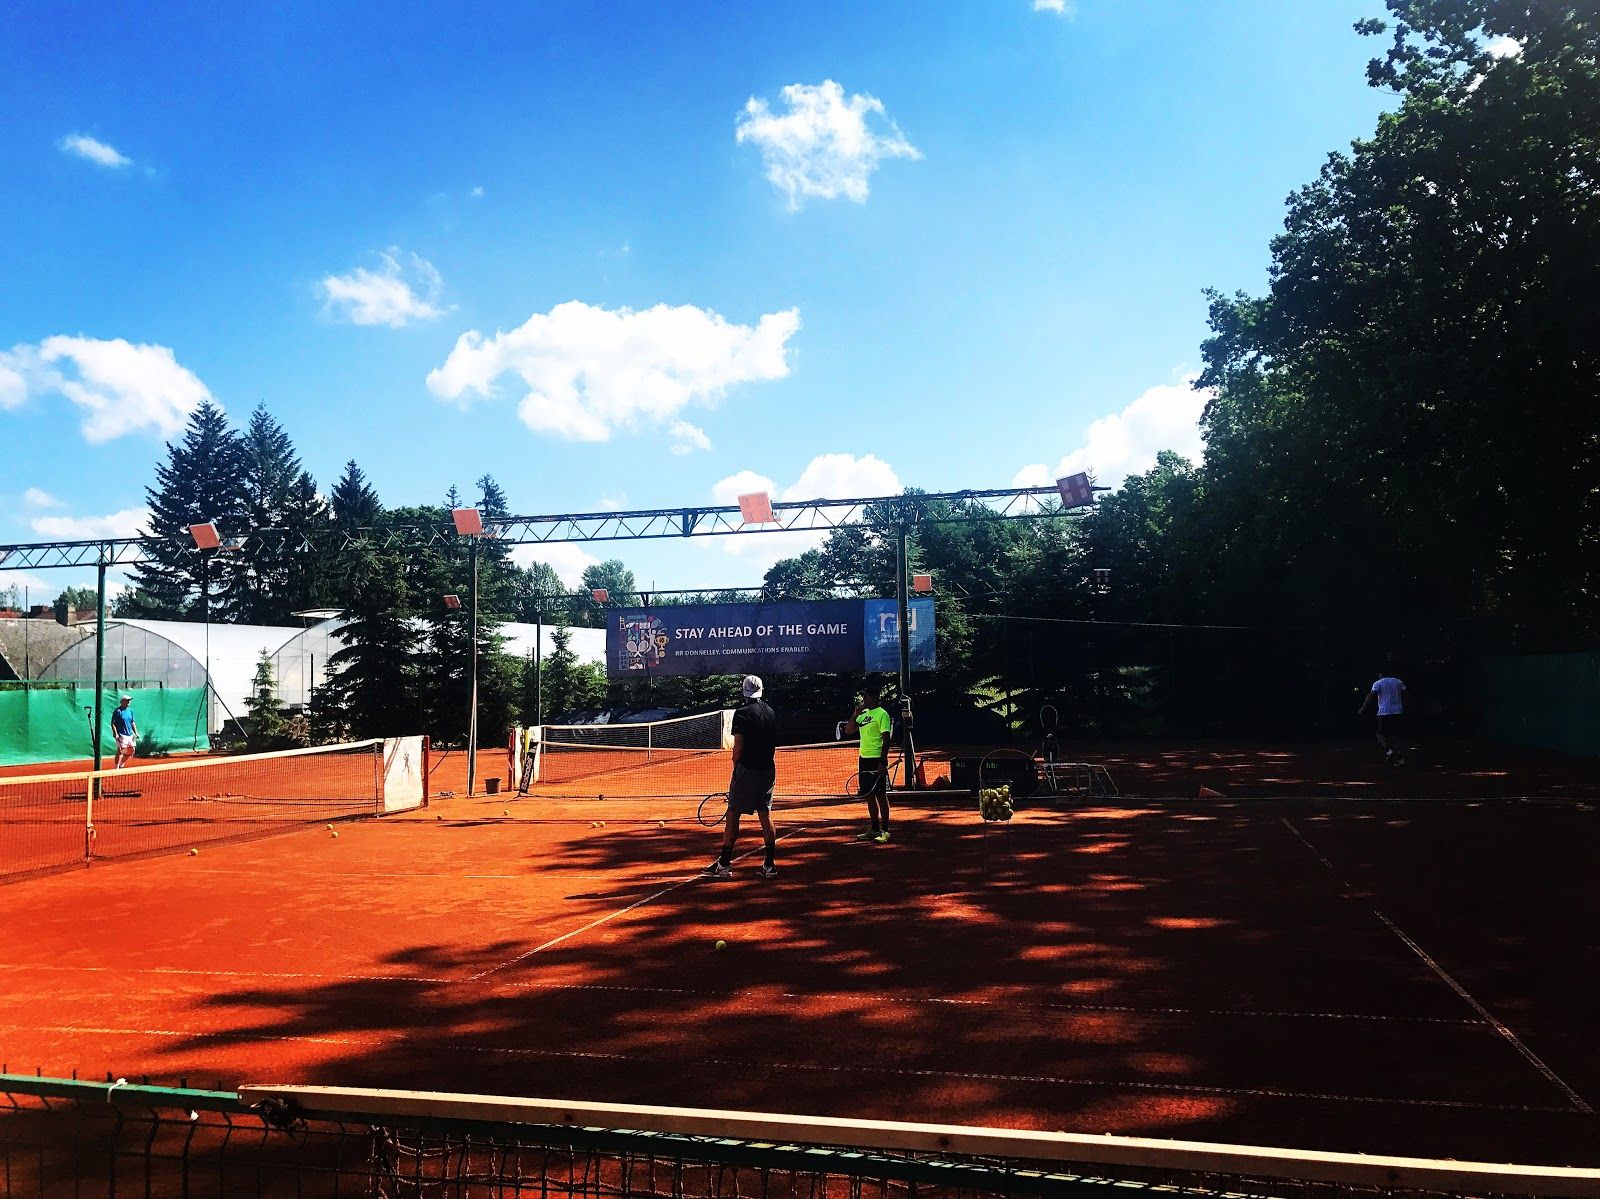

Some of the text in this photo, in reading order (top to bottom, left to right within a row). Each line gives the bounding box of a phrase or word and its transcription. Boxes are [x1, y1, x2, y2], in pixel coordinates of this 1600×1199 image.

[676, 623, 848, 639] STAY AHEAD OF THE GAME
[722, 647, 780, 656] COMMUNICATIONS
